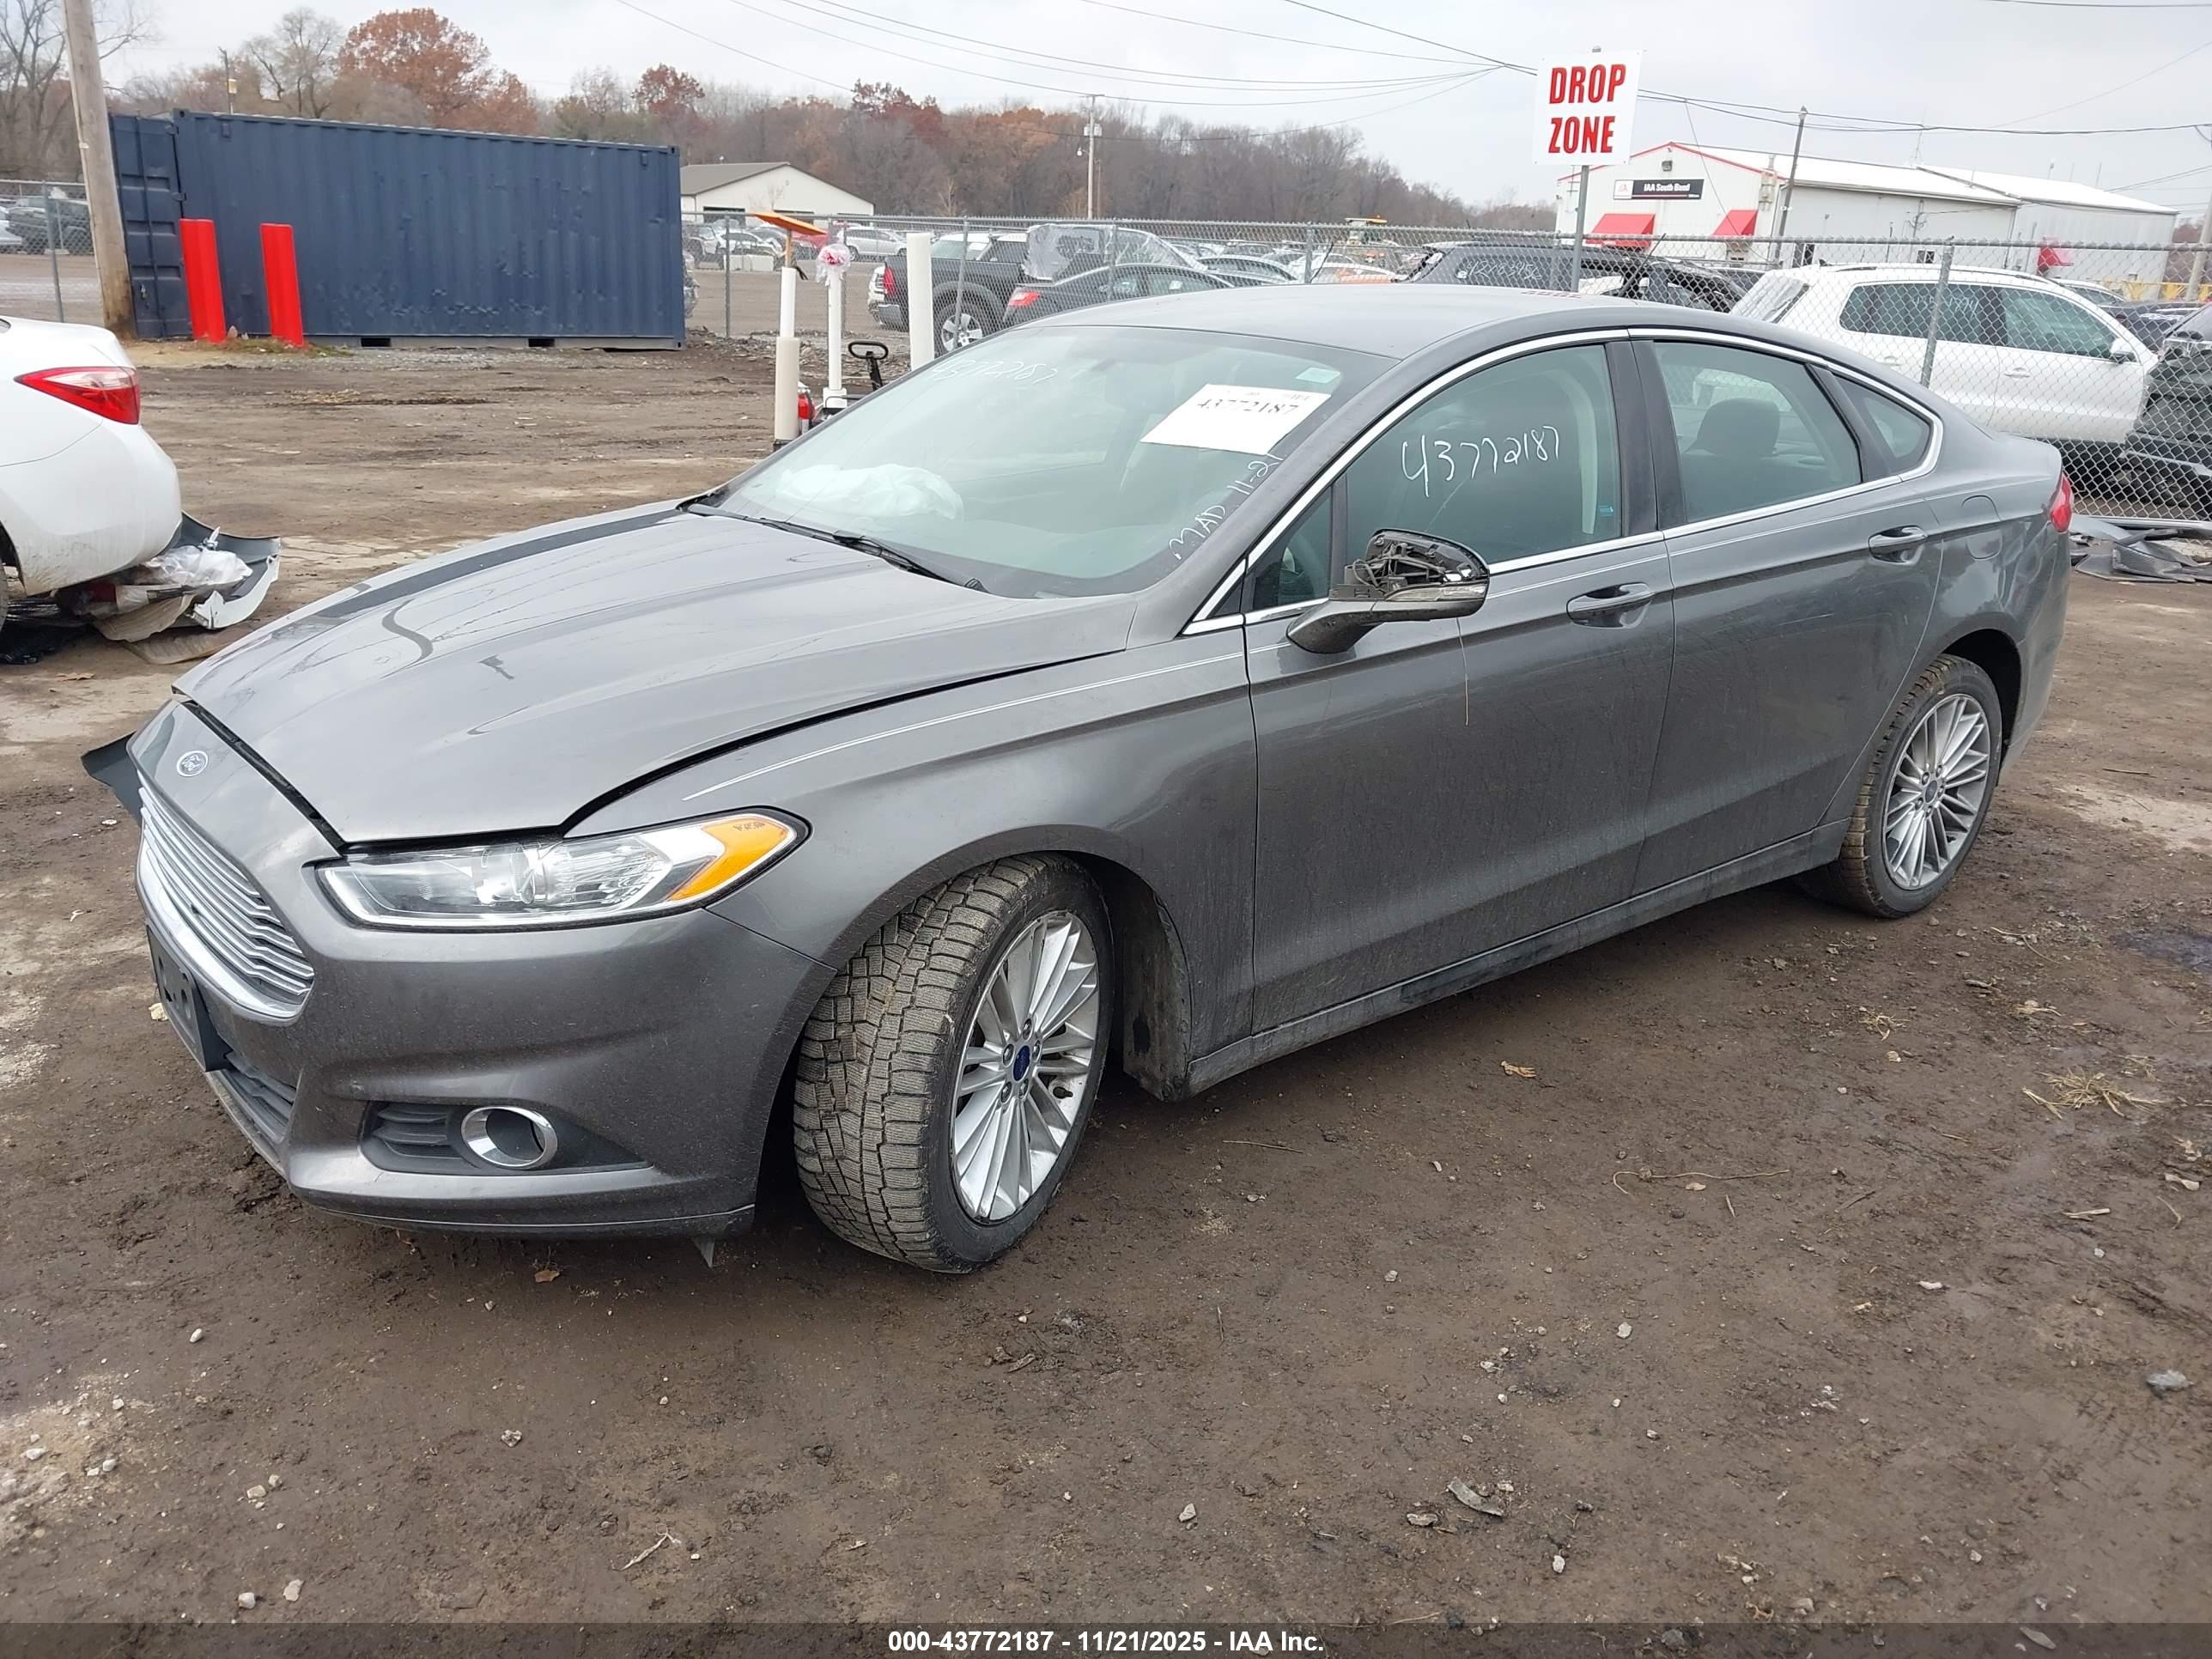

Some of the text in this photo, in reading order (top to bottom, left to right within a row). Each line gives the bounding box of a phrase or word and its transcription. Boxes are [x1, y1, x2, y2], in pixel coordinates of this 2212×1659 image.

[1548, 64, 1626, 104] DROP
[1548, 115, 1615, 154] ZONE
[1401, 425, 1559, 498] 43772187
